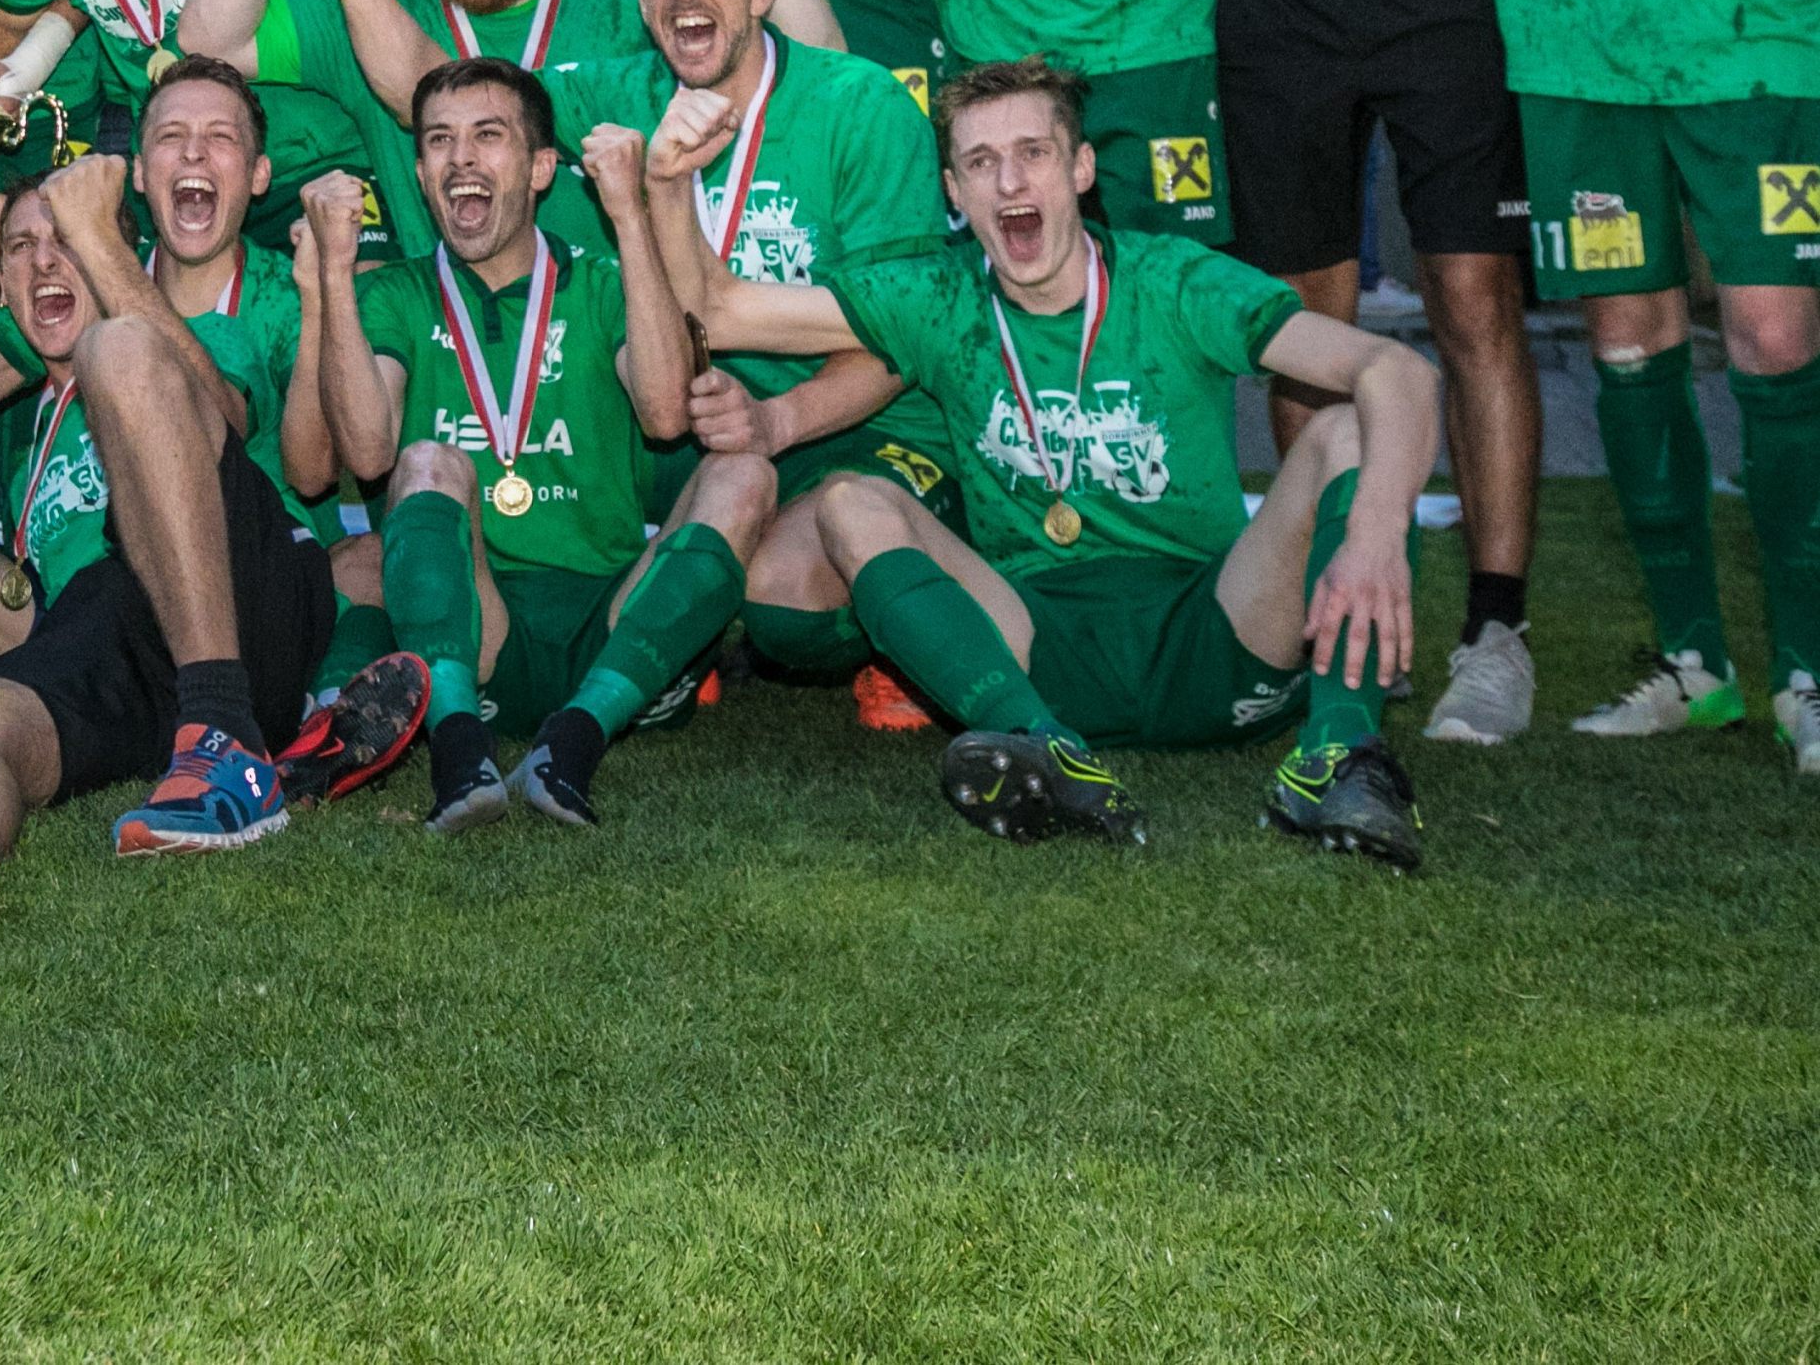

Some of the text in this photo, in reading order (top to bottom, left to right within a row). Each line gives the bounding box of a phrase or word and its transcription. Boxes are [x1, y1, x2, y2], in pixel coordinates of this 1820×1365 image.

[765, 244, 799, 267] SV
[1531, 221, 1566, 271] 11
[434, 408, 574, 457] HELA
[1116, 441, 1150, 471] SV
